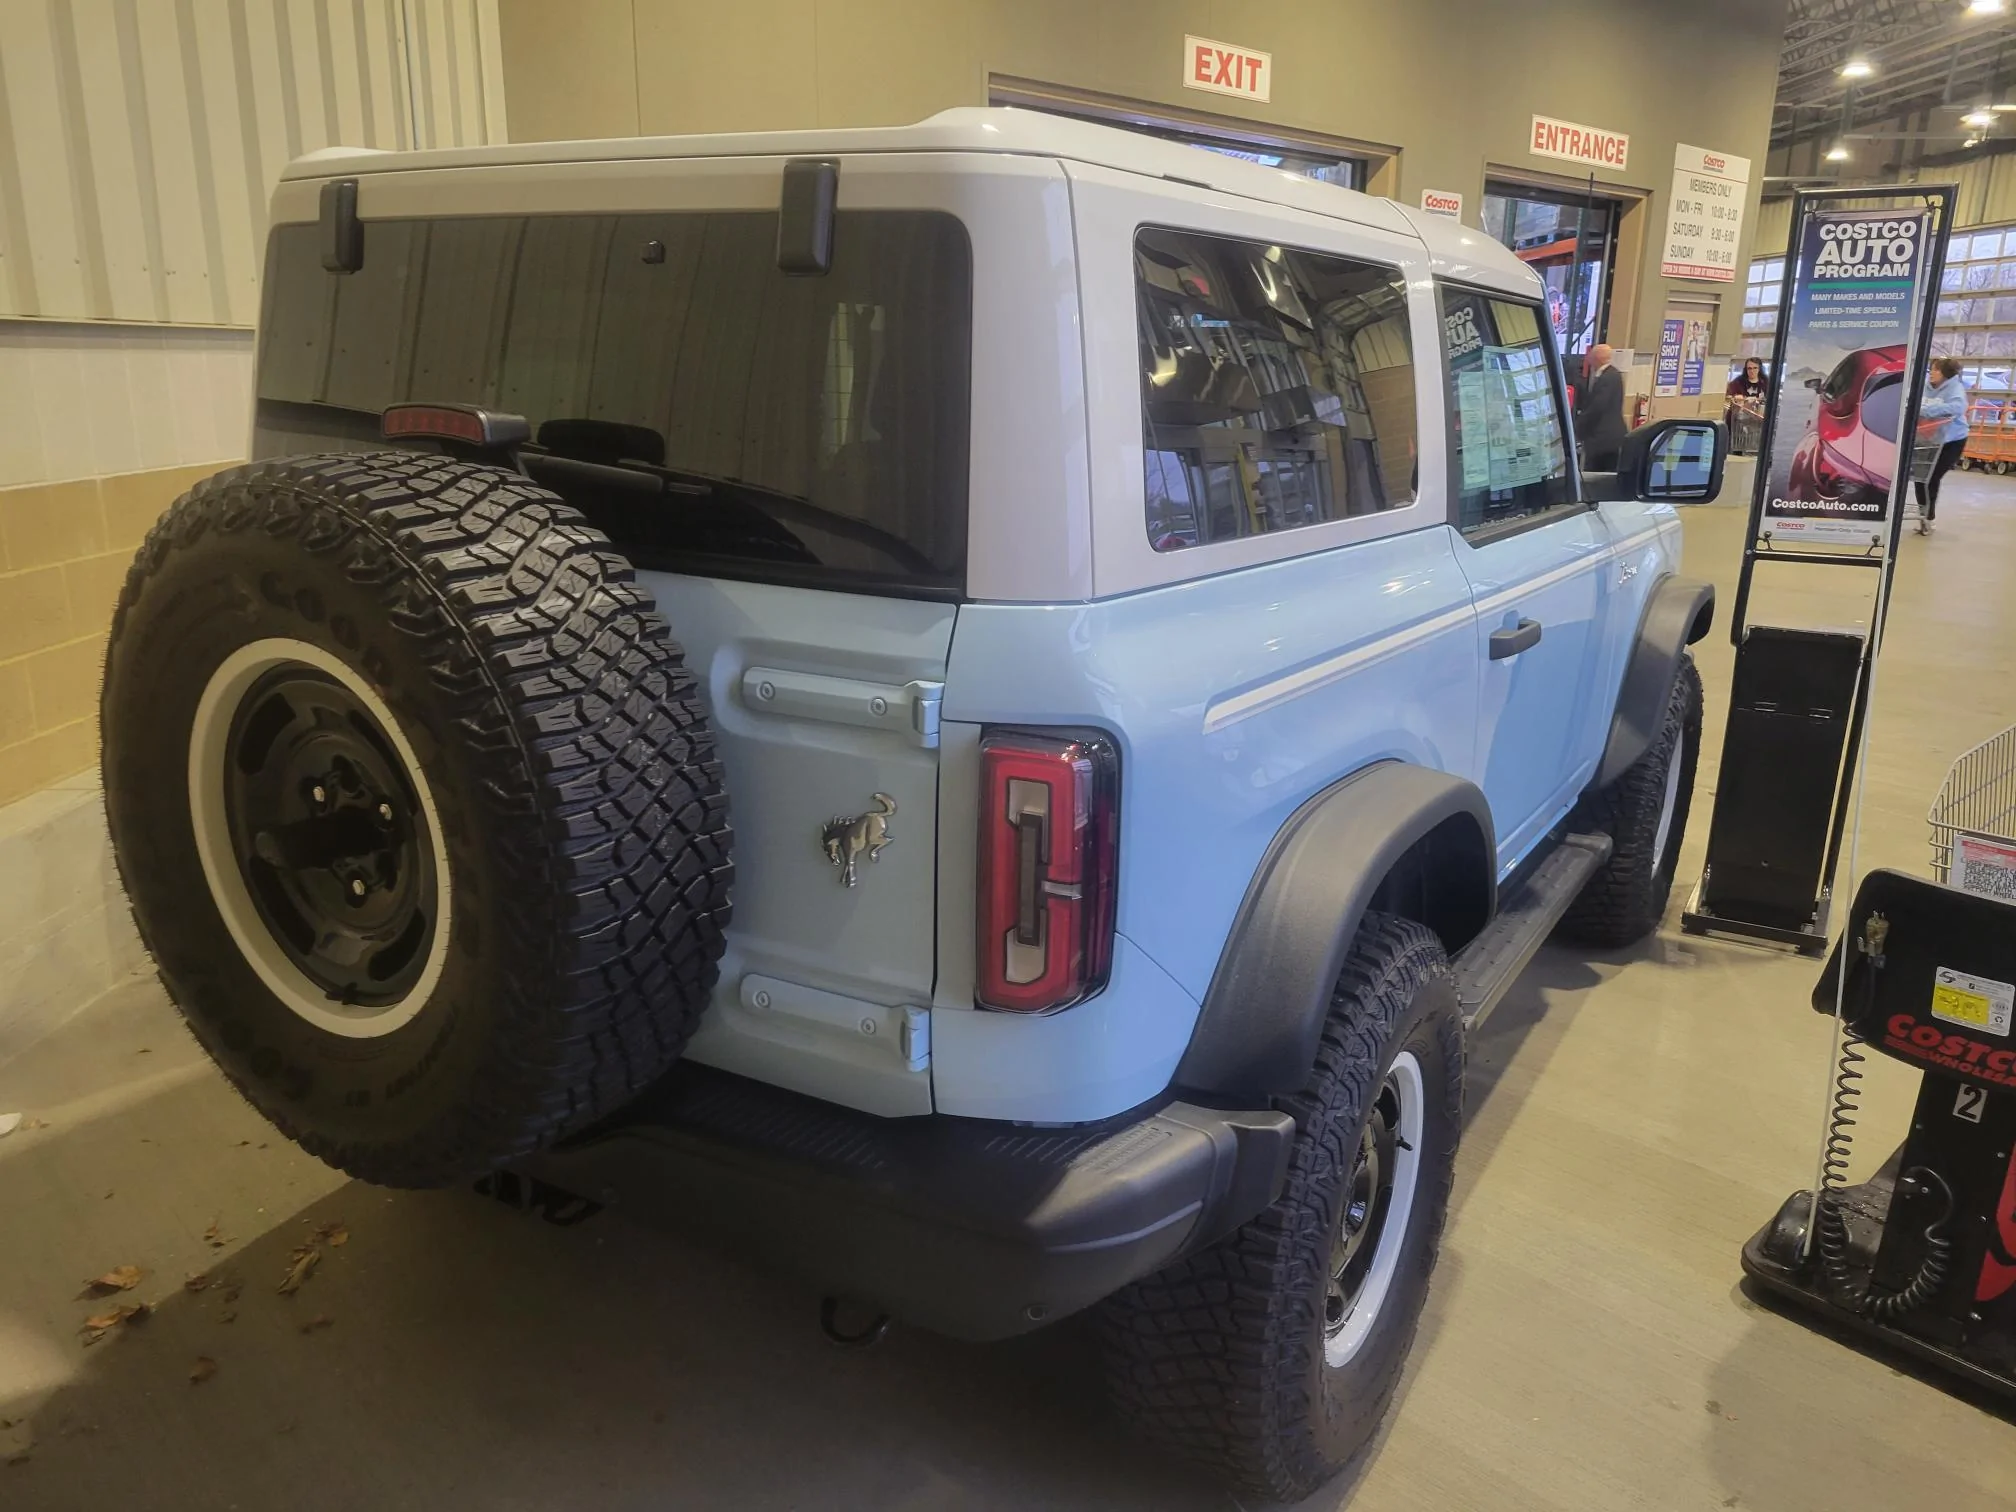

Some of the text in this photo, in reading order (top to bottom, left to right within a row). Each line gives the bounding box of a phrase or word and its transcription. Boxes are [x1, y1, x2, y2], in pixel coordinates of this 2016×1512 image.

[1194, 45, 1262, 92] EXIT
[1533, 121, 1626, 165] ENTRANCE
[1703, 154, 1725, 169] COSTCO
[1690, 178, 1732, 198] MEMBERS ONLY
[1425, 194, 1459, 211] COSTCO
[1676, 199, 1690, 214] MON
[1693, 203, 1704, 216] FRI
[1672, 222, 1704, 239] SATURDAY
[1820, 221, 1917, 240] COSTCO
[1669, 244, 1695, 259] SUNDAY
[1815, 238, 1914, 265] AUTO
[1813, 263, 1911, 278] PROGRAM
[1811, 293, 1832, 301] MANY
[1875, 292, 1905, 300] MODELS
[1815, 306, 1897, 315] LIMITED-TIME SPECIALS
[1809, 320, 1831, 328] PARTS
[1839, 320, 1868, 328] SERVICE
[1869, 320, 1899, 328] COUPON
[1662, 330, 1676, 343] FLU
[1661, 345, 1680, 357] SHOT
[1659, 358, 1678, 371] HERE
[1772, 498, 1879, 512] CostcoAuto.com
[1887, 1013, 2016, 1074] COSTC
[1957, 1086, 1982, 1120] 2
